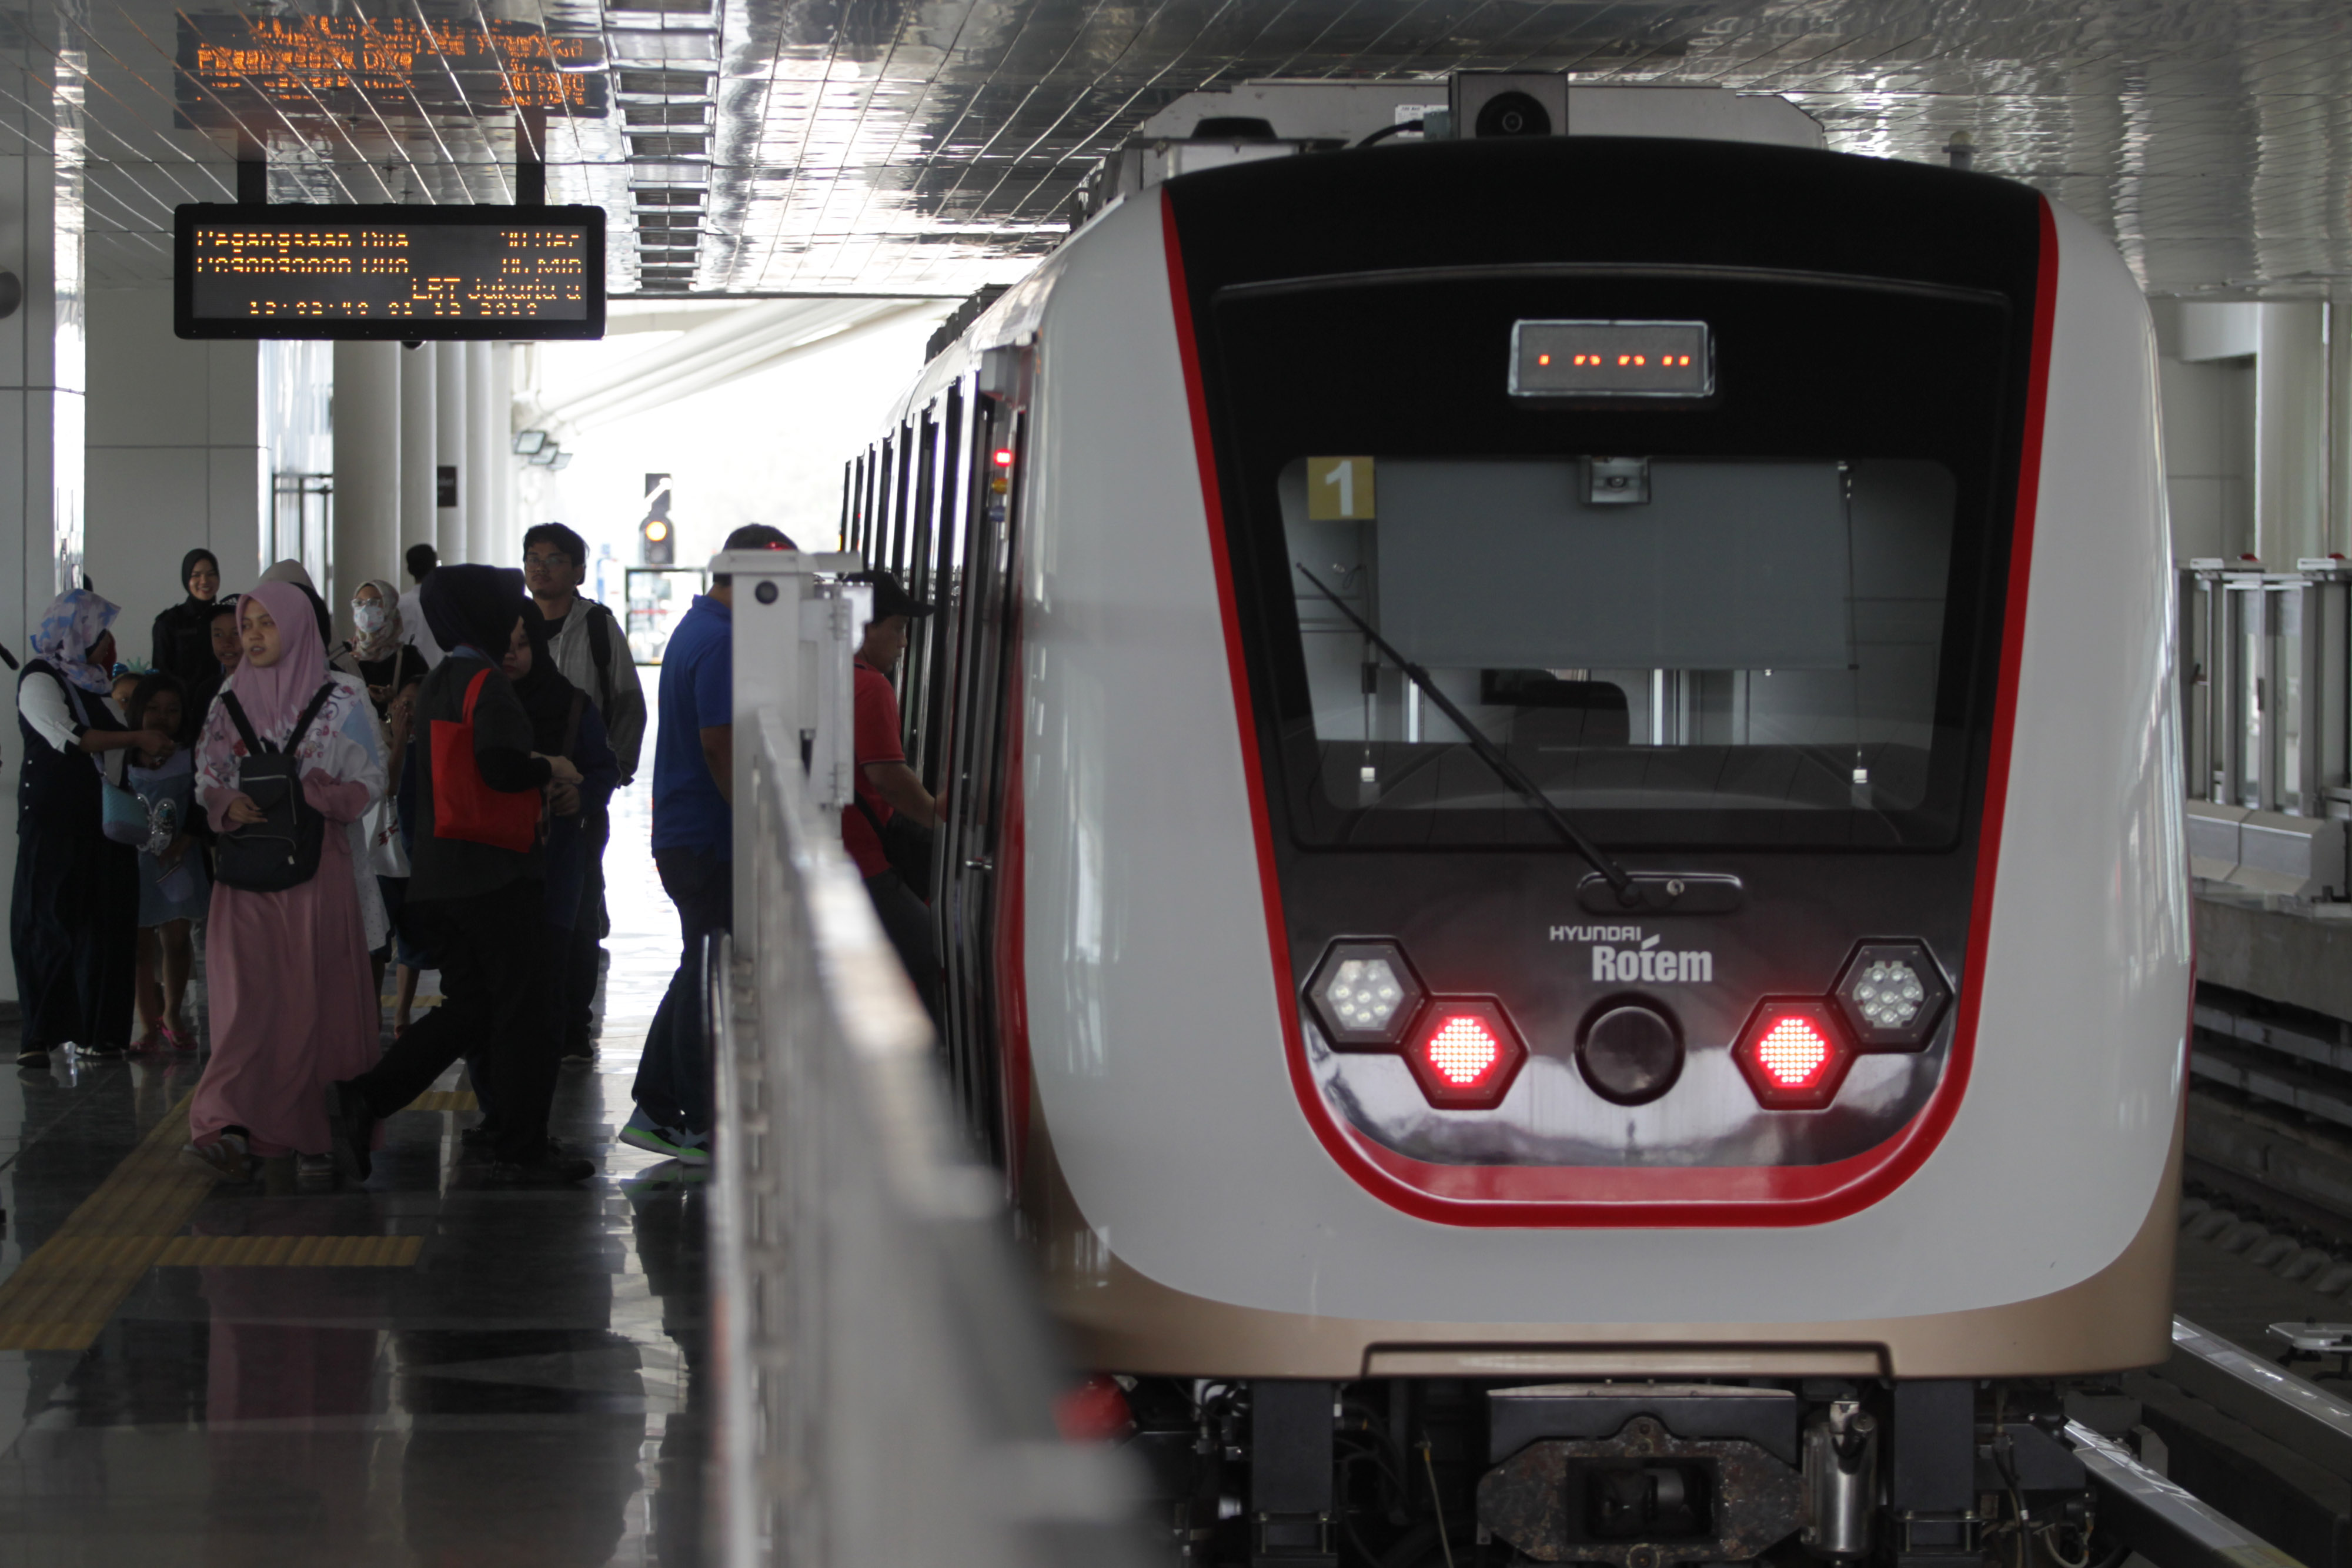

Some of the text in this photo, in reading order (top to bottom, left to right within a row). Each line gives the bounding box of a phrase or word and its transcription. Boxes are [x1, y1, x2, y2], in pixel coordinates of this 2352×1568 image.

[1326, 460, 1353, 516] 1
[1549, 925, 1642, 941] HYUNDAI
[1592, 934, 1713, 982] Rotem
